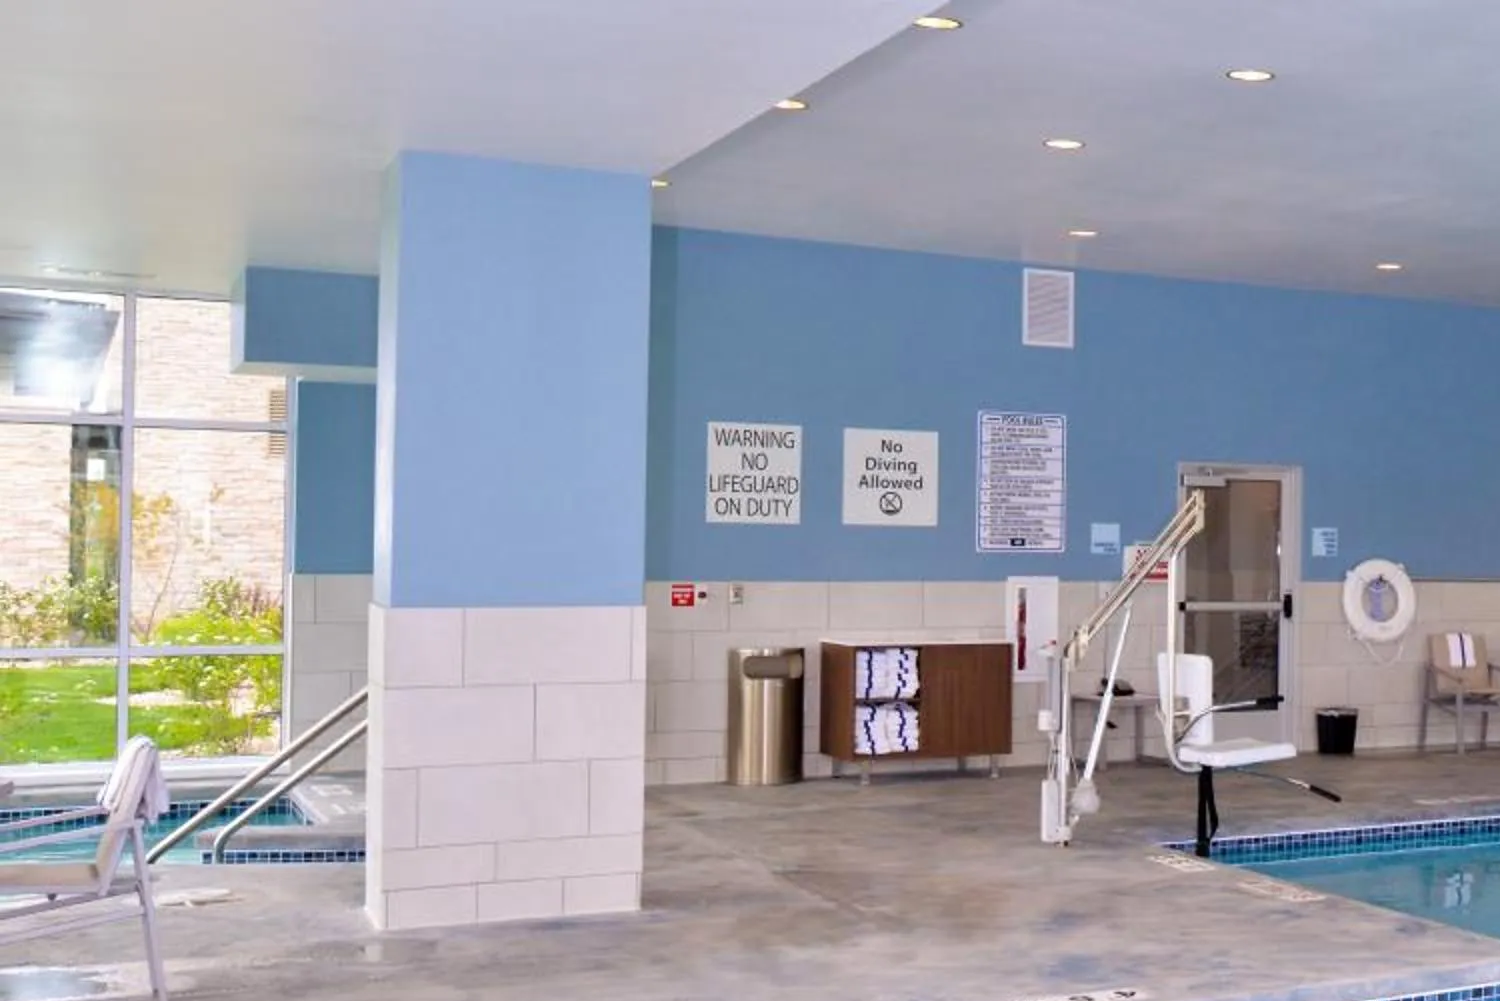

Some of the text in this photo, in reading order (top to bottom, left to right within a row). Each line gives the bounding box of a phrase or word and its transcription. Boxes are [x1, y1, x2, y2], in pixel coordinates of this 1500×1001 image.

[714, 428, 795, 449] WARNING
[881, 439, 903, 453] No
[741, 453, 769, 471] NO
[865, 457, 918, 475] Diving
[709, 475, 799, 495] LIFEGUARD
[858, 475, 923, 490] Allowed
[715, 498, 793, 517] ON DUTY
